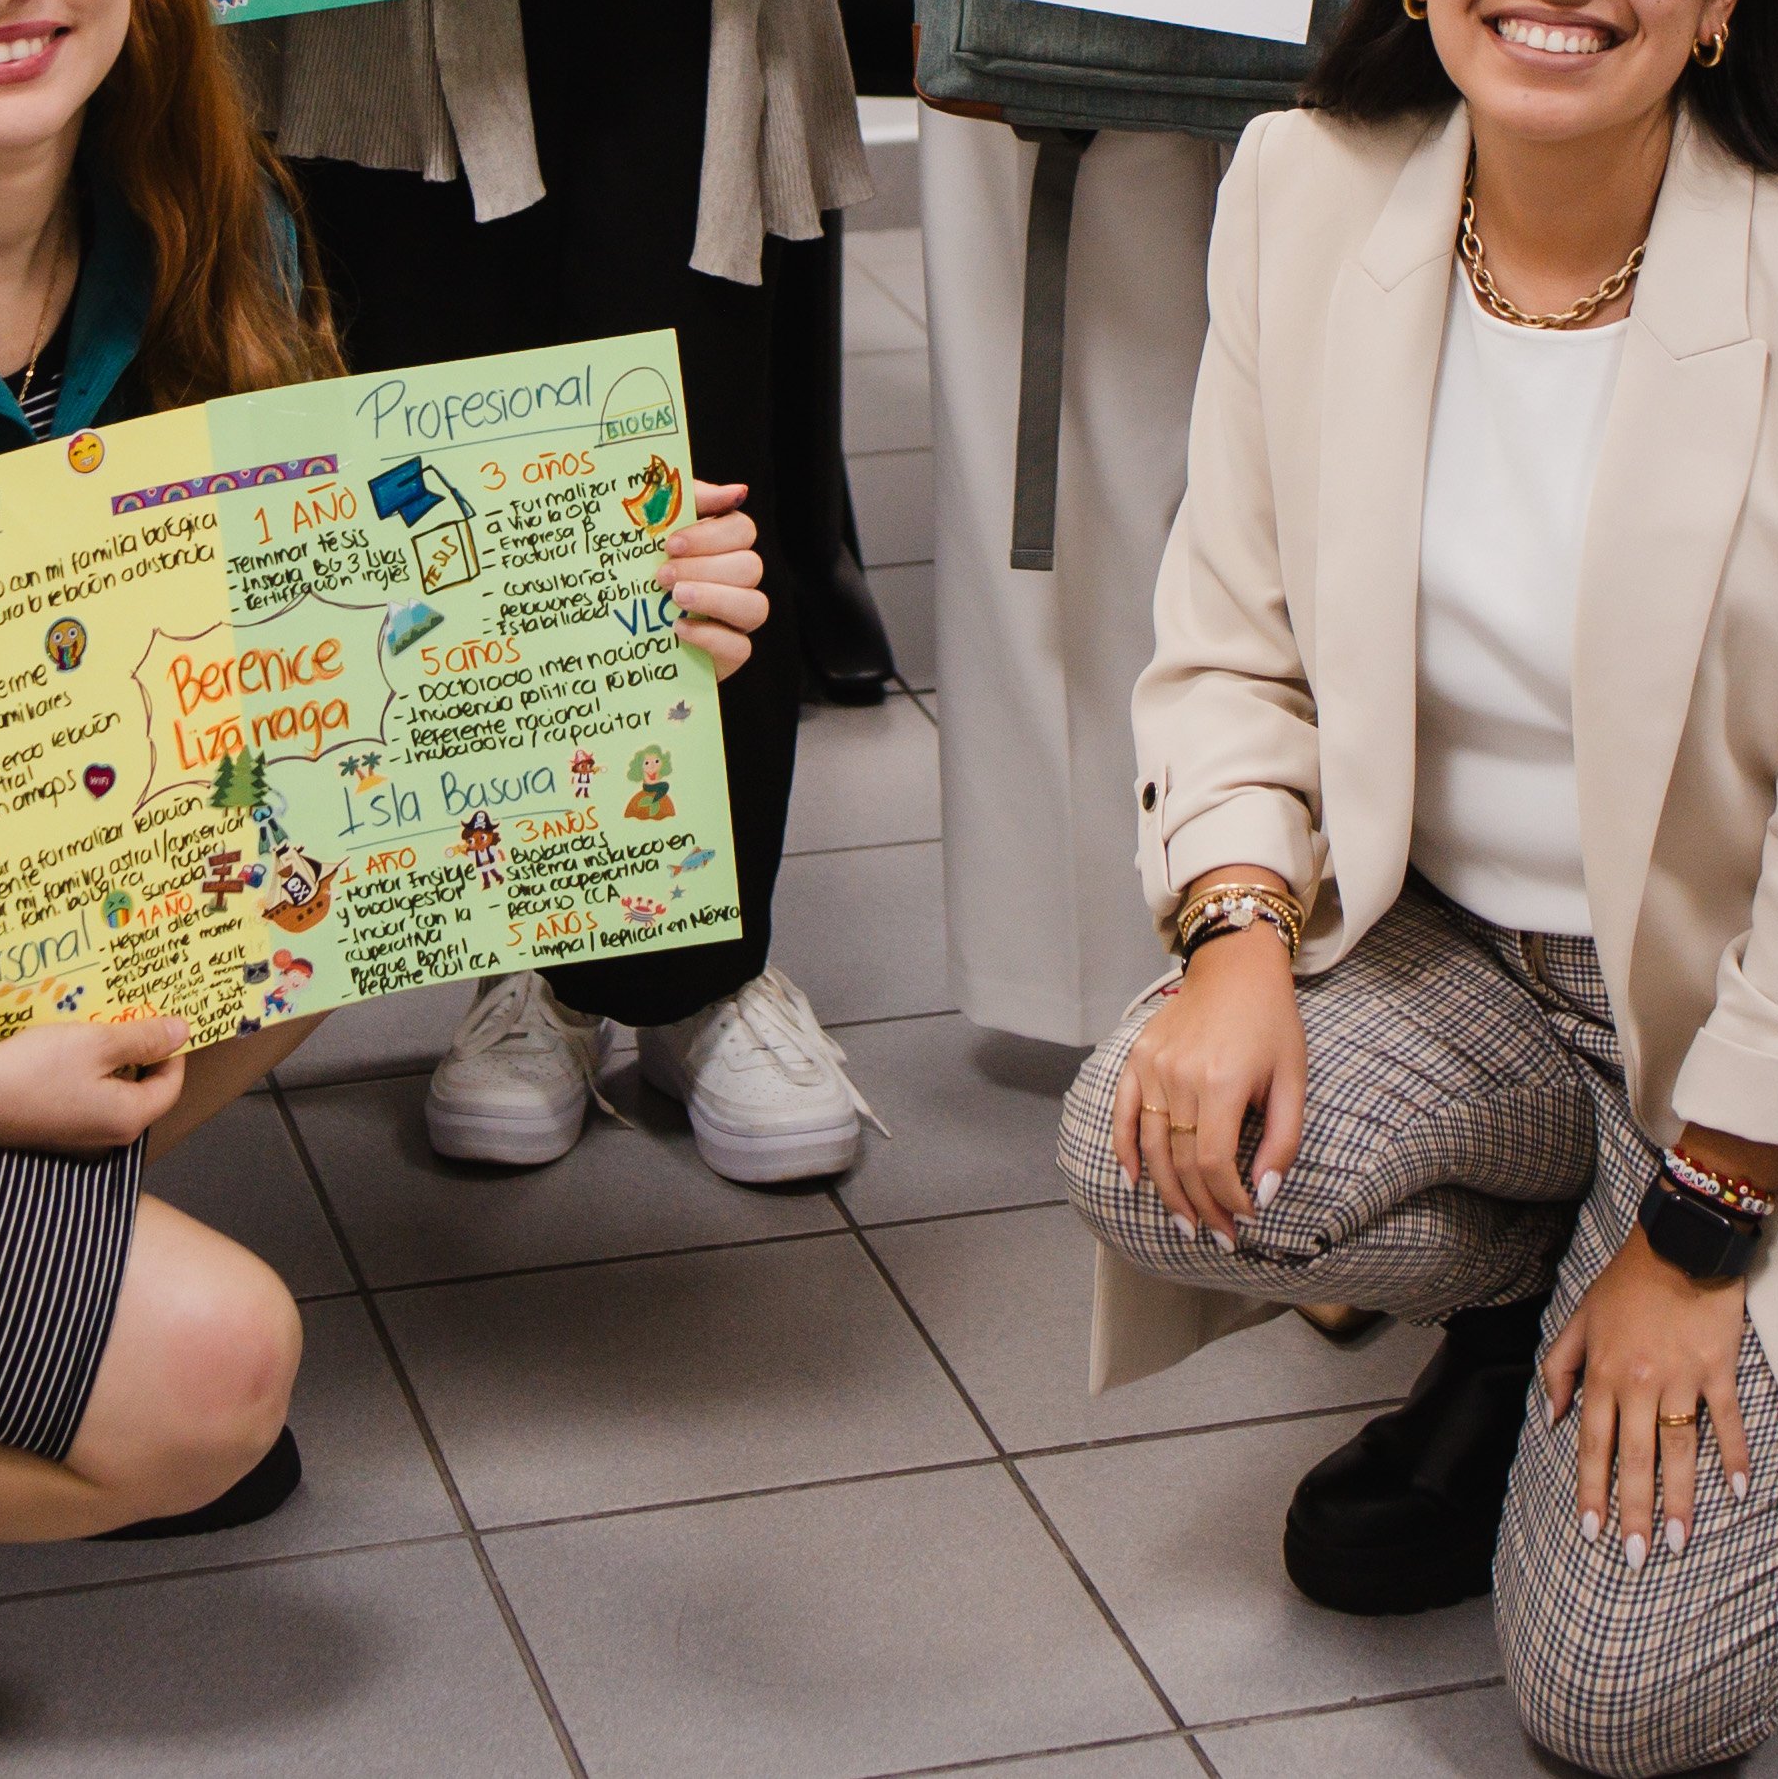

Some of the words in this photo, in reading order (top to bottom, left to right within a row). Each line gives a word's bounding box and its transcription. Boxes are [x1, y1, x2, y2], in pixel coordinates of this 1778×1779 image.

[355, 364, 594, 441] Profesional
[603, 407, 677, 443] BIOGAS
[478, 459, 508, 492] 3
[522, 449, 596, 482] años
[253, 505, 273, 545] 1
[292, 482, 358, 532] AÑO
[508, 477, 619, 515] Formalizar
[498, 523, 577, 558] Empresa
[345, 551, 361, 574] 3
[420, 645, 441, 678] 5
[445, 635, 522, 673] años
[166, 637, 345, 718] Berenice
[418, 665, 532, 704] Doctorado
[338, 782, 421, 838] Isla
[439, 764, 557, 817] Basura
[514, 817, 540, 844] 3
[363, 845, 418, 877] AÑO
[582, 882, 622, 907] CCA
[532, 906, 599, 942] AÑOS
